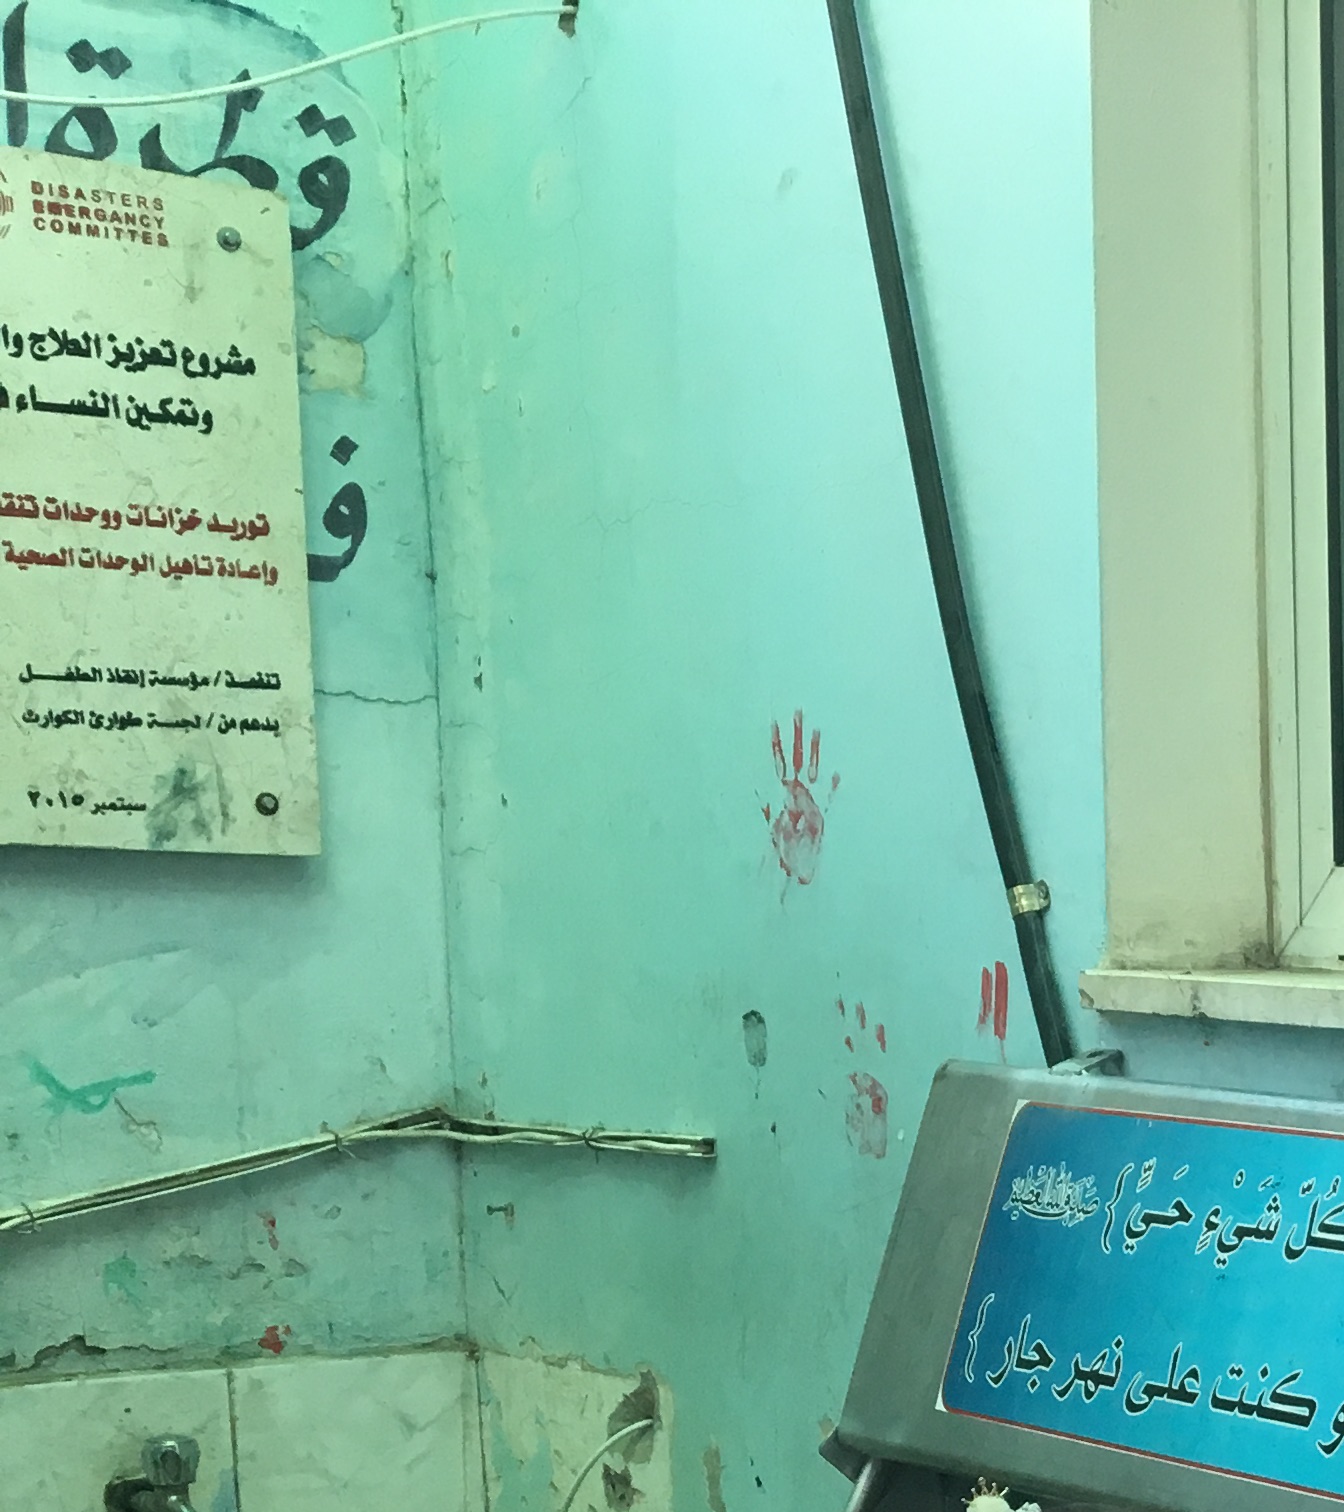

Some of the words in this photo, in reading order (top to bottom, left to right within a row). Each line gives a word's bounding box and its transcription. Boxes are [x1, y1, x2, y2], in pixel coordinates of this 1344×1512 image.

[31, 180, 165, 212] DISASTERS
[33, 217, 169, 248] COMMITTES
[181, 343, 257, 380] مشروع
[125, 395, 215, 435] وتمكين
[43, 496, 123, 531] ووحدات
[126, 503, 203, 535] خزانات
[207, 512, 271, 541] توريد
[78, 547, 155, 576] الوحدات
[217, 556, 280, 586] وإعادة
[22, 708, 86, 729] الكوارث
[218, 713, 238, 735] من
[90, 796, 147, 816] سبتمبر
[985, 1312, 1056, 1393] جار
[1053, 1334, 1125, 1405] نهر
[1123, 1341, 1201, 1416] على
[1208, 1362, 1319, 1431] كنت
